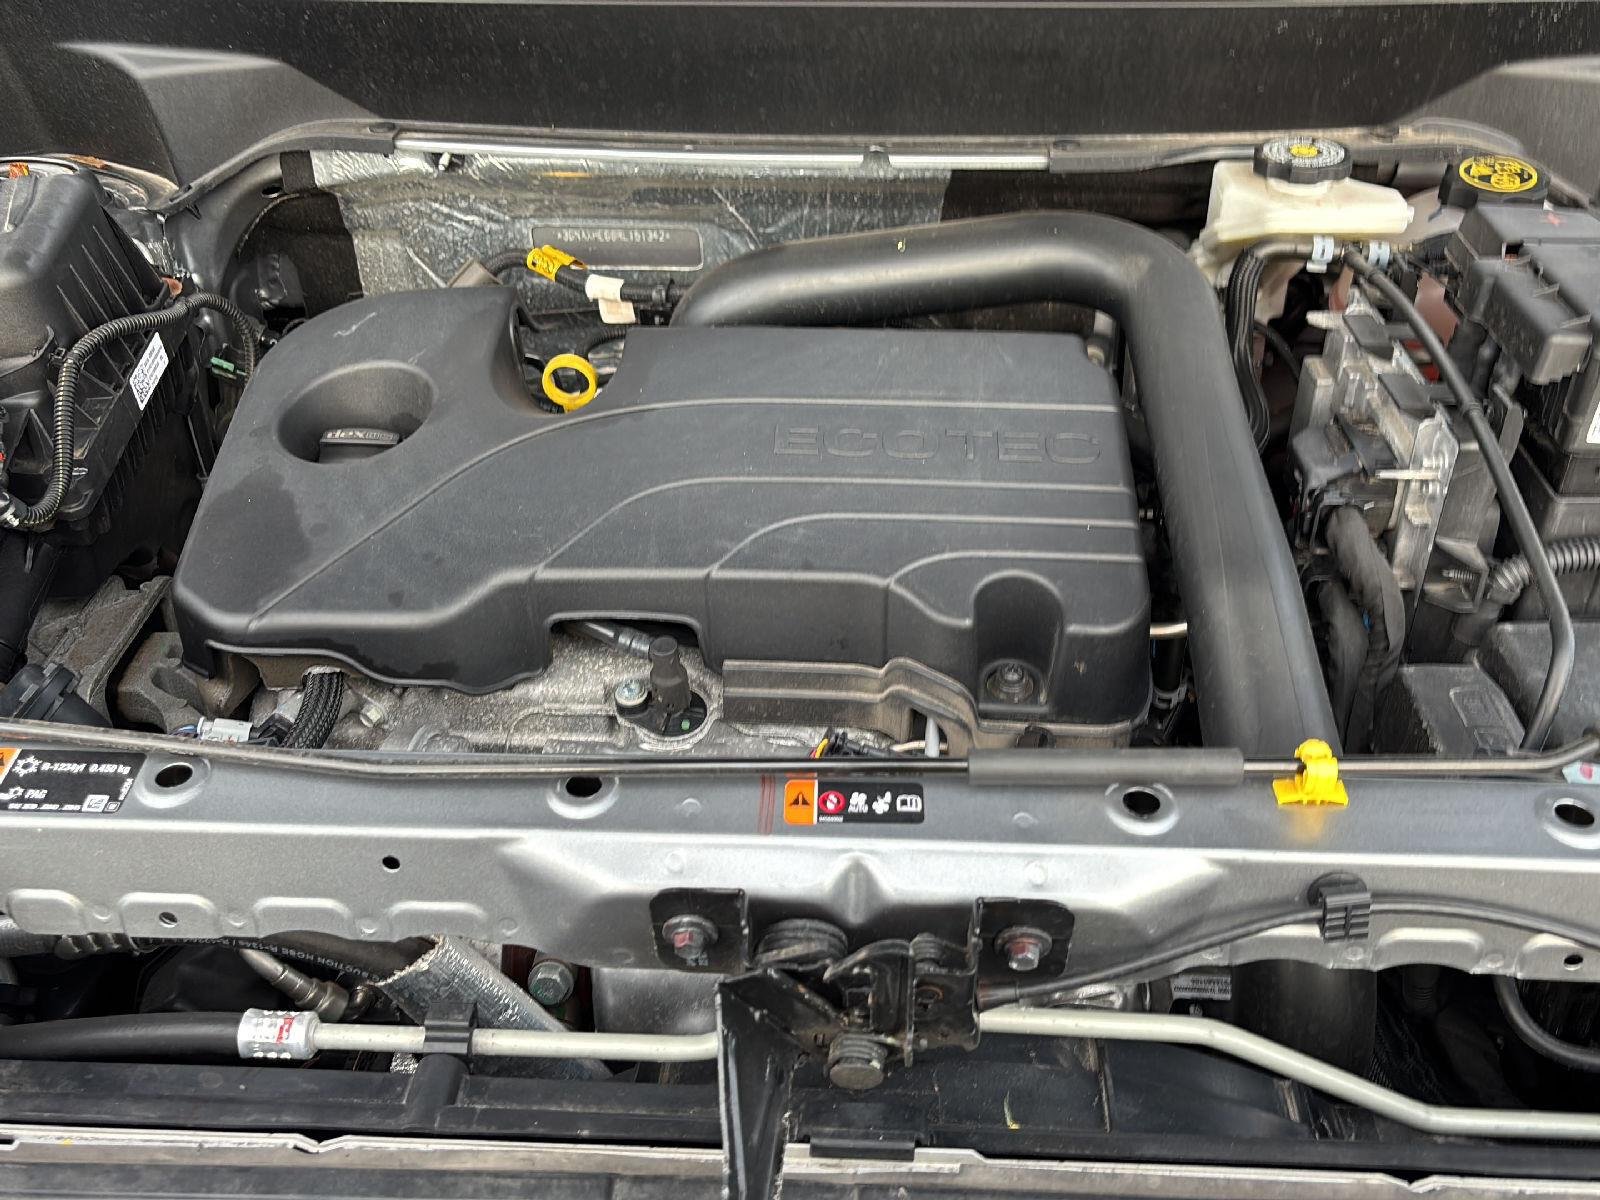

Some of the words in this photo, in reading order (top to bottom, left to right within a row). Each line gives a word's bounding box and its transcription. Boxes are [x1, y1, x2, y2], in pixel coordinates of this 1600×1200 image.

[773, 424, 1101, 464] ECOTEC
[24, 788, 48, 799] PAG
[281, 947, 314, 960] HOSE
